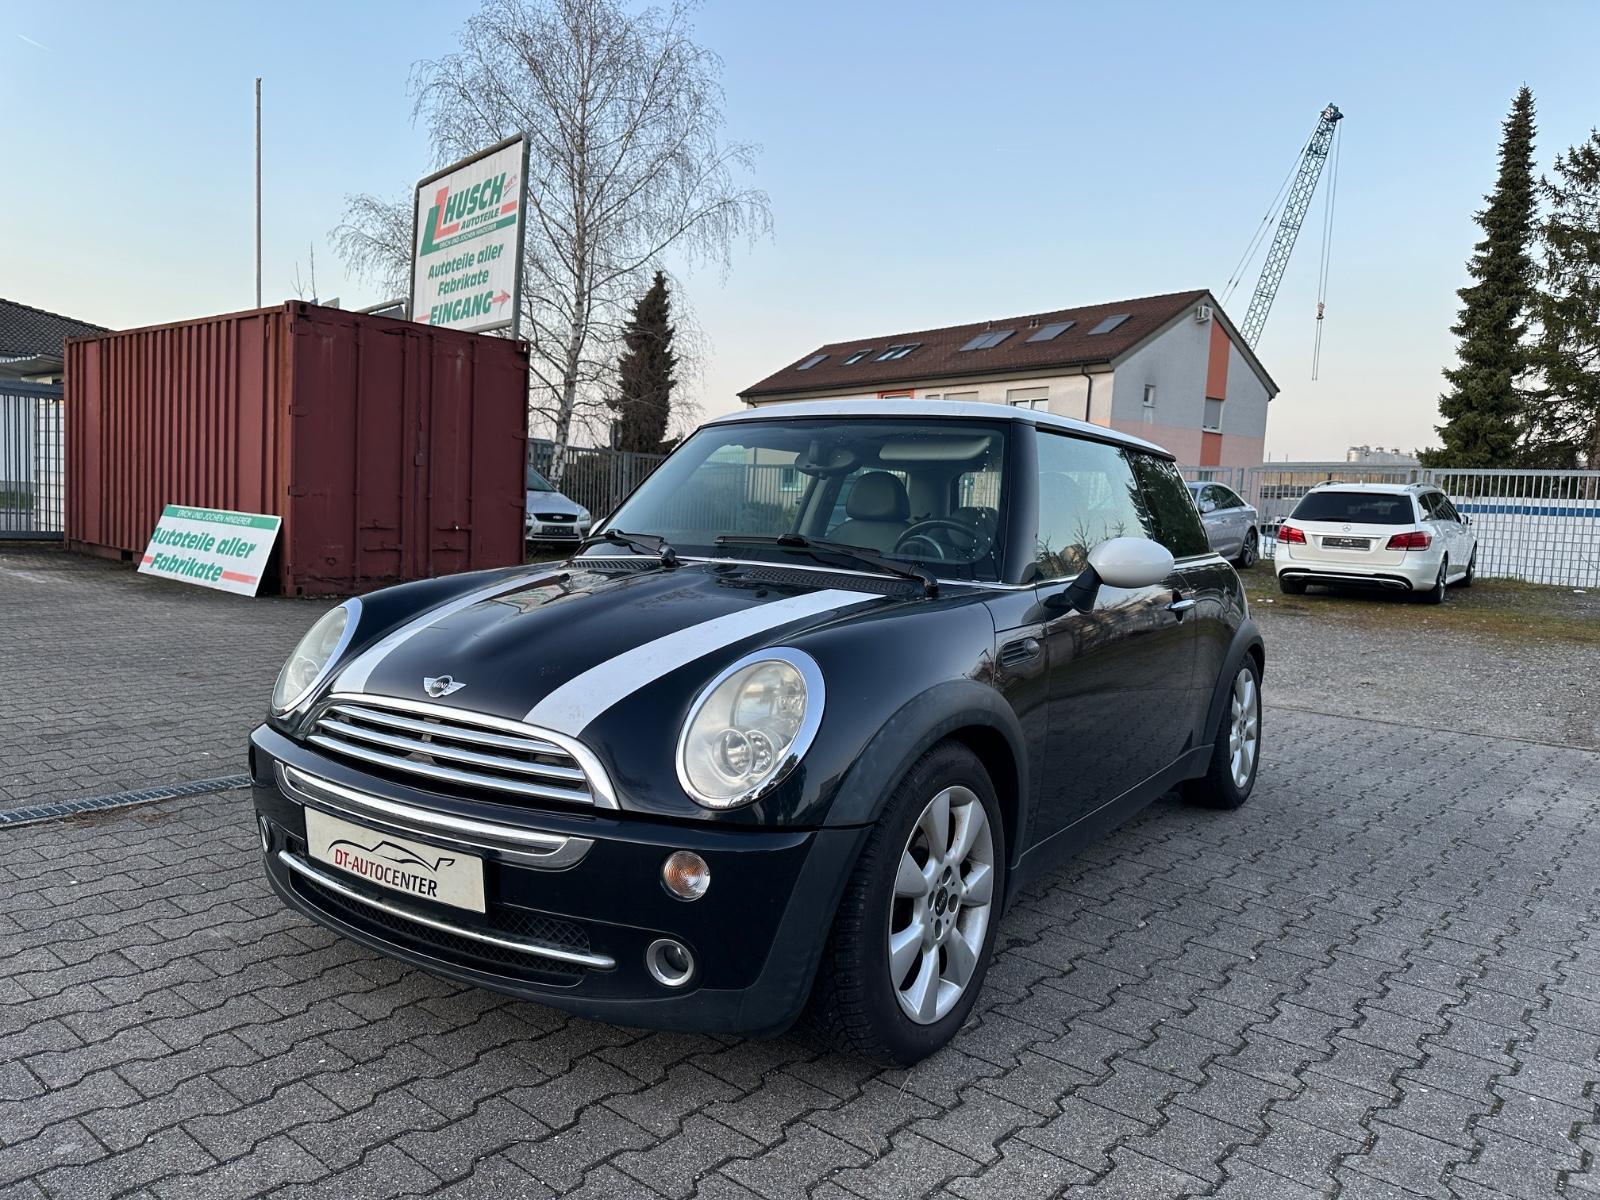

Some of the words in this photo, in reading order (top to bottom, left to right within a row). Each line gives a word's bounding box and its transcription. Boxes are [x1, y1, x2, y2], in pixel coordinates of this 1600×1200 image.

[443, 172, 506, 225] HUSCH
[461, 207, 500, 231] AUTOTEILE
[428, 251, 475, 280] Autoteile
[477, 243, 504, 264] aller
[438, 269, 489, 296] Fabrikate
[429, 290, 494, 325] EINGANG
[176, 510, 192, 518] ERICH
[192, 511, 203, 519] UND
[203, 512, 224, 522] JOCHEN
[224, 514, 252, 525] HINDERER
[216, 537, 257, 559] aller
[150, 552, 224, 582] Fabrikate
[334, 848, 437, 898] DT-AUTOCENTER
